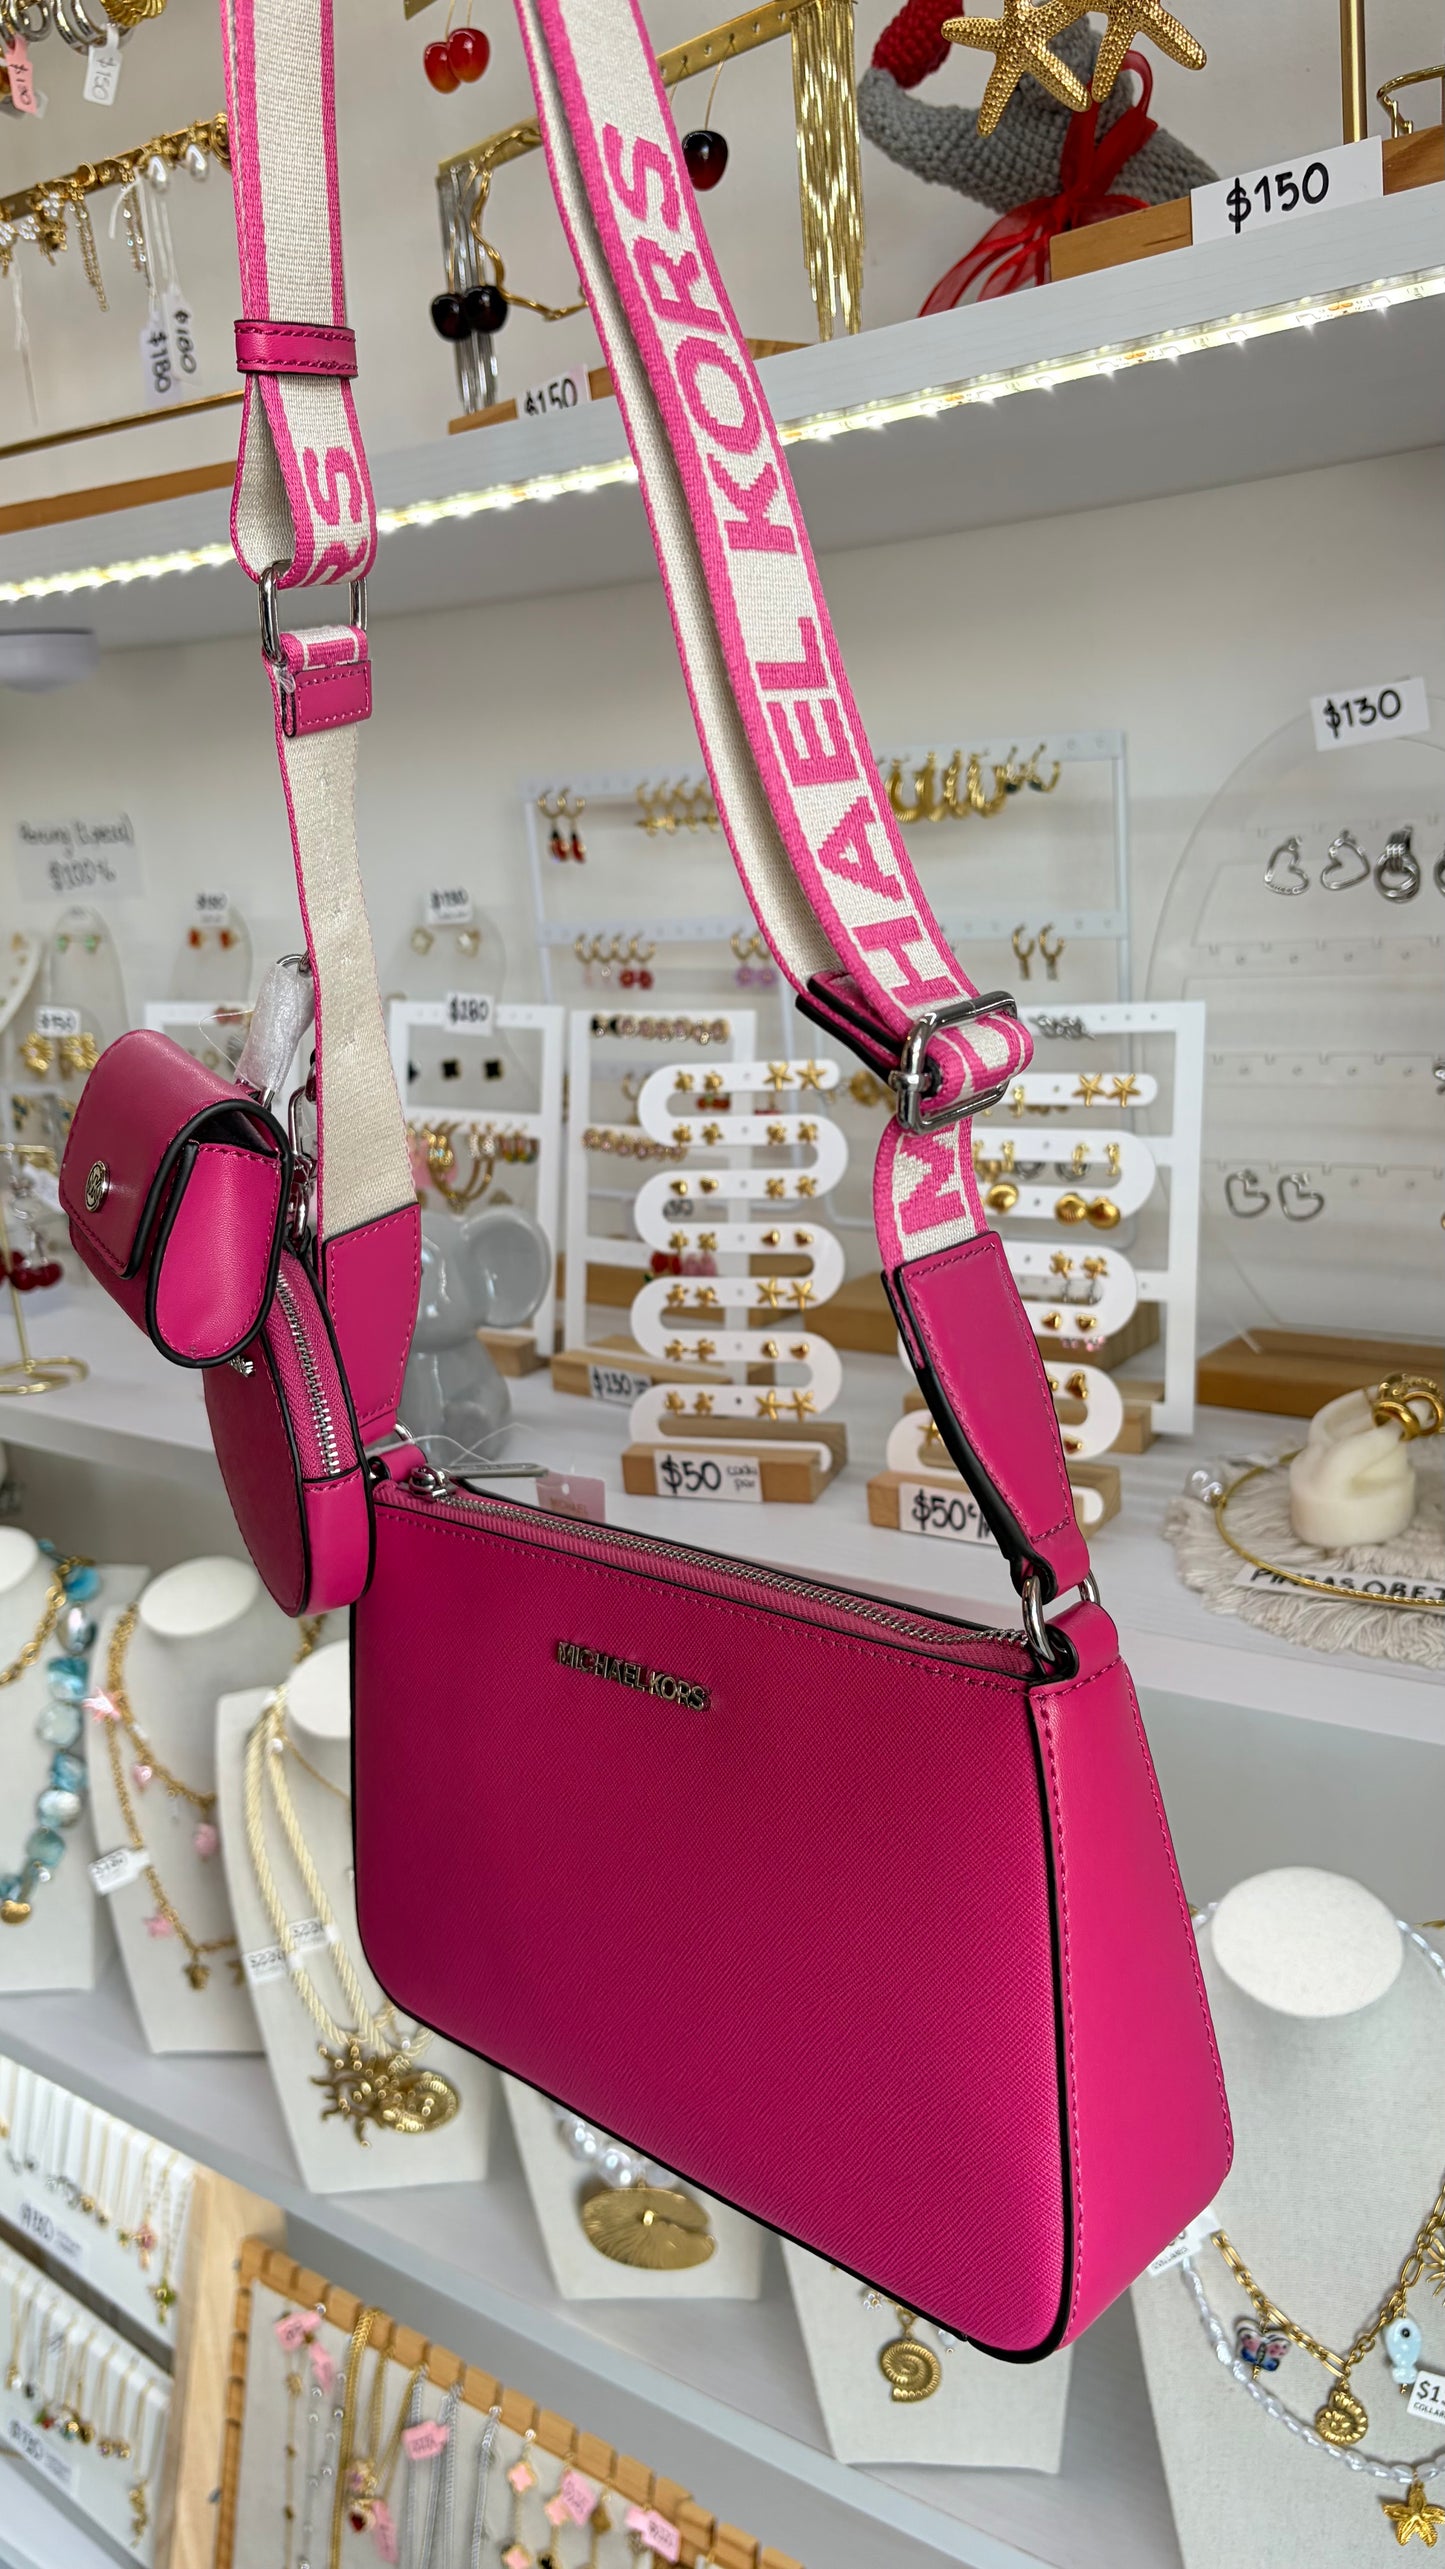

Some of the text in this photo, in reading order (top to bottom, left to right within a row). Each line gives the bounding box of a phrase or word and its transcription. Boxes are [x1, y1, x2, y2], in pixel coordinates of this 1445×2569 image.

[1225, 161, 1330, 235] $150
[148, 330, 172, 393] $180
[601, 122, 798, 556] KORS
[1322, 688, 1402, 740] $130
[660, 1453, 722, 1495] $50
[911, 1487, 966, 1532] $50
[556, 1641, 711, 1712] MICHAEL KORS
